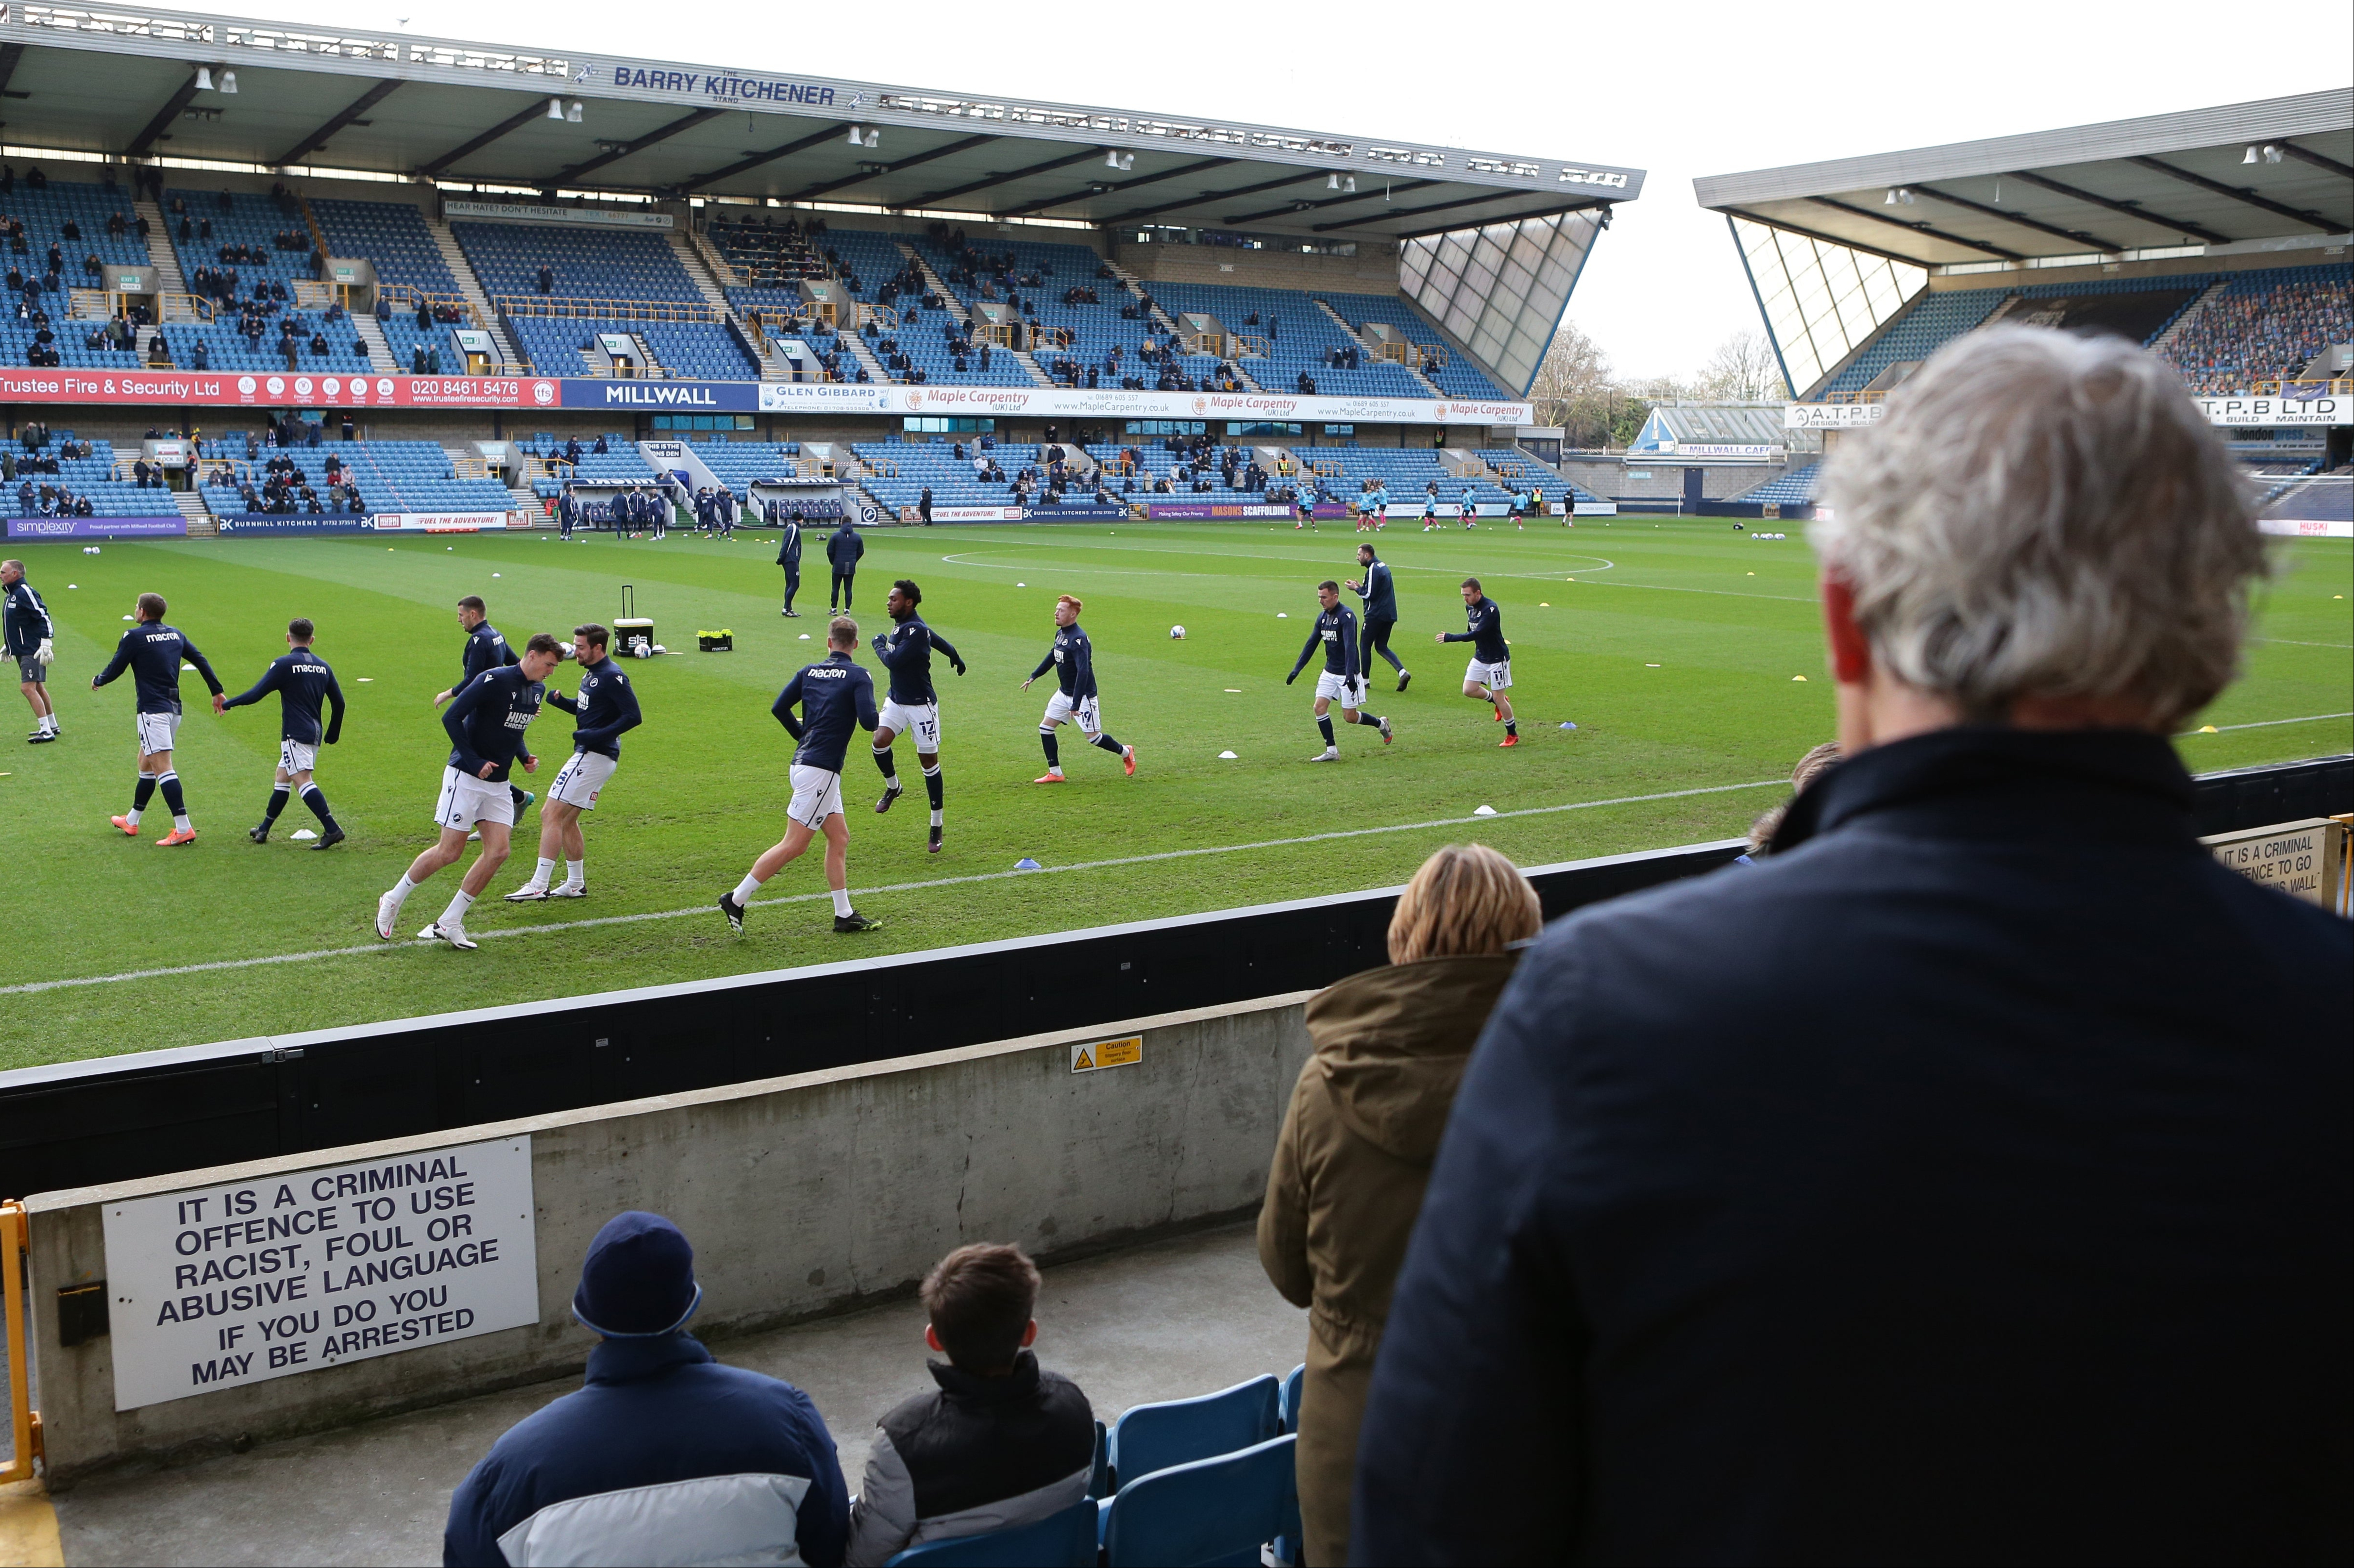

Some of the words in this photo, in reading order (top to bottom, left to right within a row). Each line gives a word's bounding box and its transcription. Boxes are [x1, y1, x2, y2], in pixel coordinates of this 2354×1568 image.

[614, 67, 698, 92] BARRY
[705, 75, 835, 106] KITCHENER
[713, 96, 739, 104] STAND
[447, 202, 470, 211] HEAR
[473, 203, 499, 212] HATE?
[501, 205, 528, 214] DON'T
[531, 207, 567, 217] HESITATE
[65, 379, 98, 394] Fire
[103, 379, 116, 394] &
[122, 380, 189, 399] Security
[195, 381, 219, 396] Ltd
[411, 381, 437, 394] 020
[444, 382, 477, 394] 8461
[484, 382, 518, 395] 5476
[537, 388, 551, 397] tfs
[777, 386, 813, 396] GLEN
[818, 387, 875, 397] GIBBARD
[413, 395, 518, 404] www.trusteefiresecurity.com
[606, 386, 716, 405] MILLWALL
[927, 389, 966, 403] Maple
[969, 391, 1029, 407] Carpentry
[992, 403, 1008, 411] (UK)
[1054, 402, 1169, 413] www.MapleCarpentry.co.uk
[1211, 396, 1243, 409] Maple
[1245, 397, 1297, 412] Carpentry
[1450, 403, 1481, 415] Maple
[1481, 404, 1524, 417] Carpentry
[2283, 400, 2336, 414] LTD
[1318, 408, 1415, 417] www.MapleCarpentry.co.uk
[1212, 506, 1242, 516] MASONS
[1243, 506, 1290, 516] SCAFFOLDING
[17, 520, 75, 534] simplexity
[2300, 522, 2328, 531] HUSKI
[146, 633, 180, 643] macron
[292, 664, 326, 675] macron
[807, 668, 847, 679] macron
[919, 720, 935, 736] 12
[2224, 851, 2234, 866] IT
[2237, 847, 2248, 864] IS
[2253, 846, 2260, 861] A
[2265, 836, 2313, 858] CRIMINAL
[2235, 863, 2273, 881] FENCE
[2278, 860, 2291, 876] TO
[2296, 855, 2311, 872] GO
[2290, 875, 2316, 893] WALL
[1106, 1041, 1130, 1050] Caution
[178, 1198, 208, 1225] IT
[225, 1190, 257, 1218] IS
[273, 1184, 297, 1209] A
[311, 1156, 468, 1202] CRIMINAL
[175, 1206, 338, 1256] OFFENCE
[356, 1197, 396, 1225] TO
[410, 1182, 475, 1215] USE
[175, 1244, 311, 1290] RACIST,
[326, 1226, 413, 1262] FOUL
[427, 1214, 472, 1243] OR
[156, 1275, 308, 1327] ABUSIVE
[323, 1238, 500, 1294] LANGUAGE
[219, 1324, 244, 1351] IF
[259, 1309, 320, 1344] YOU
[334, 1299, 376, 1328] DO
[389, 1284, 448, 1317] YOU
[192, 1352, 254, 1386] MAY
[269, 1342, 308, 1370] BE
[321, 1308, 475, 1359] ARRESTED
